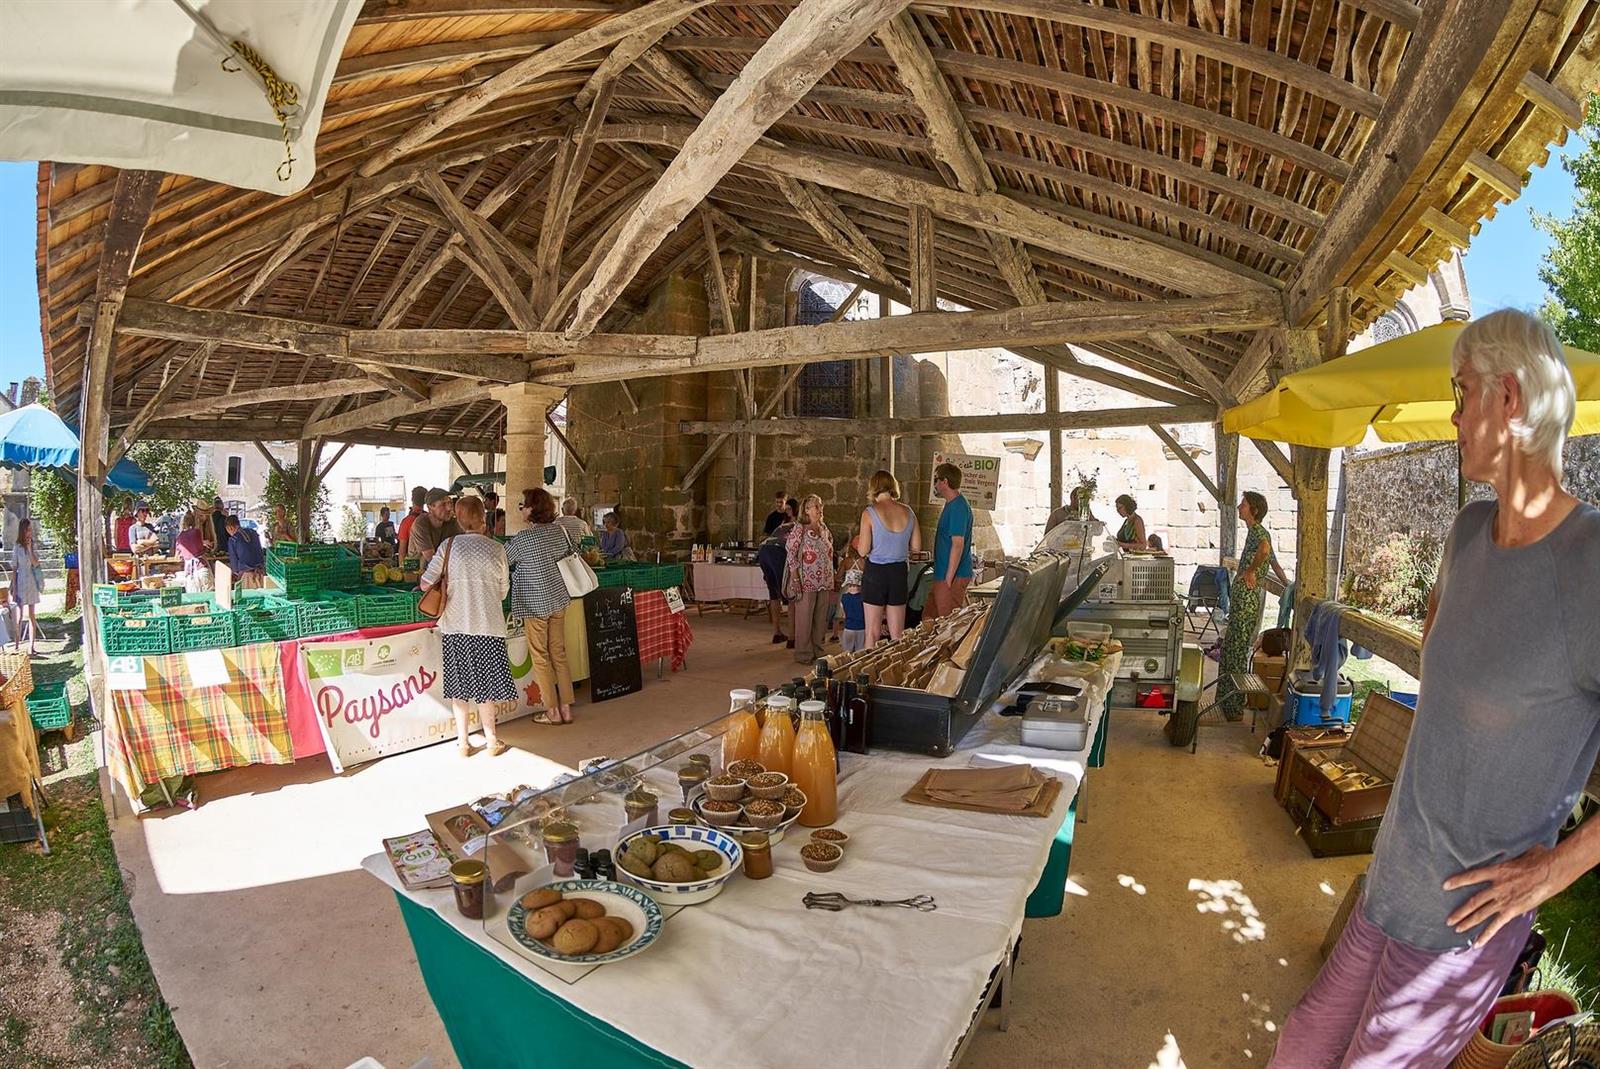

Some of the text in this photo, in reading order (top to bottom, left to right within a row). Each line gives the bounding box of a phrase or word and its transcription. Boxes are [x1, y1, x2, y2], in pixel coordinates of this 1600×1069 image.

[111, 657, 138, 673] AB
[346, 651, 362, 665] AB
[317, 665, 437, 738] Paysans
[428, 700, 518, 736] DU PRIORD
